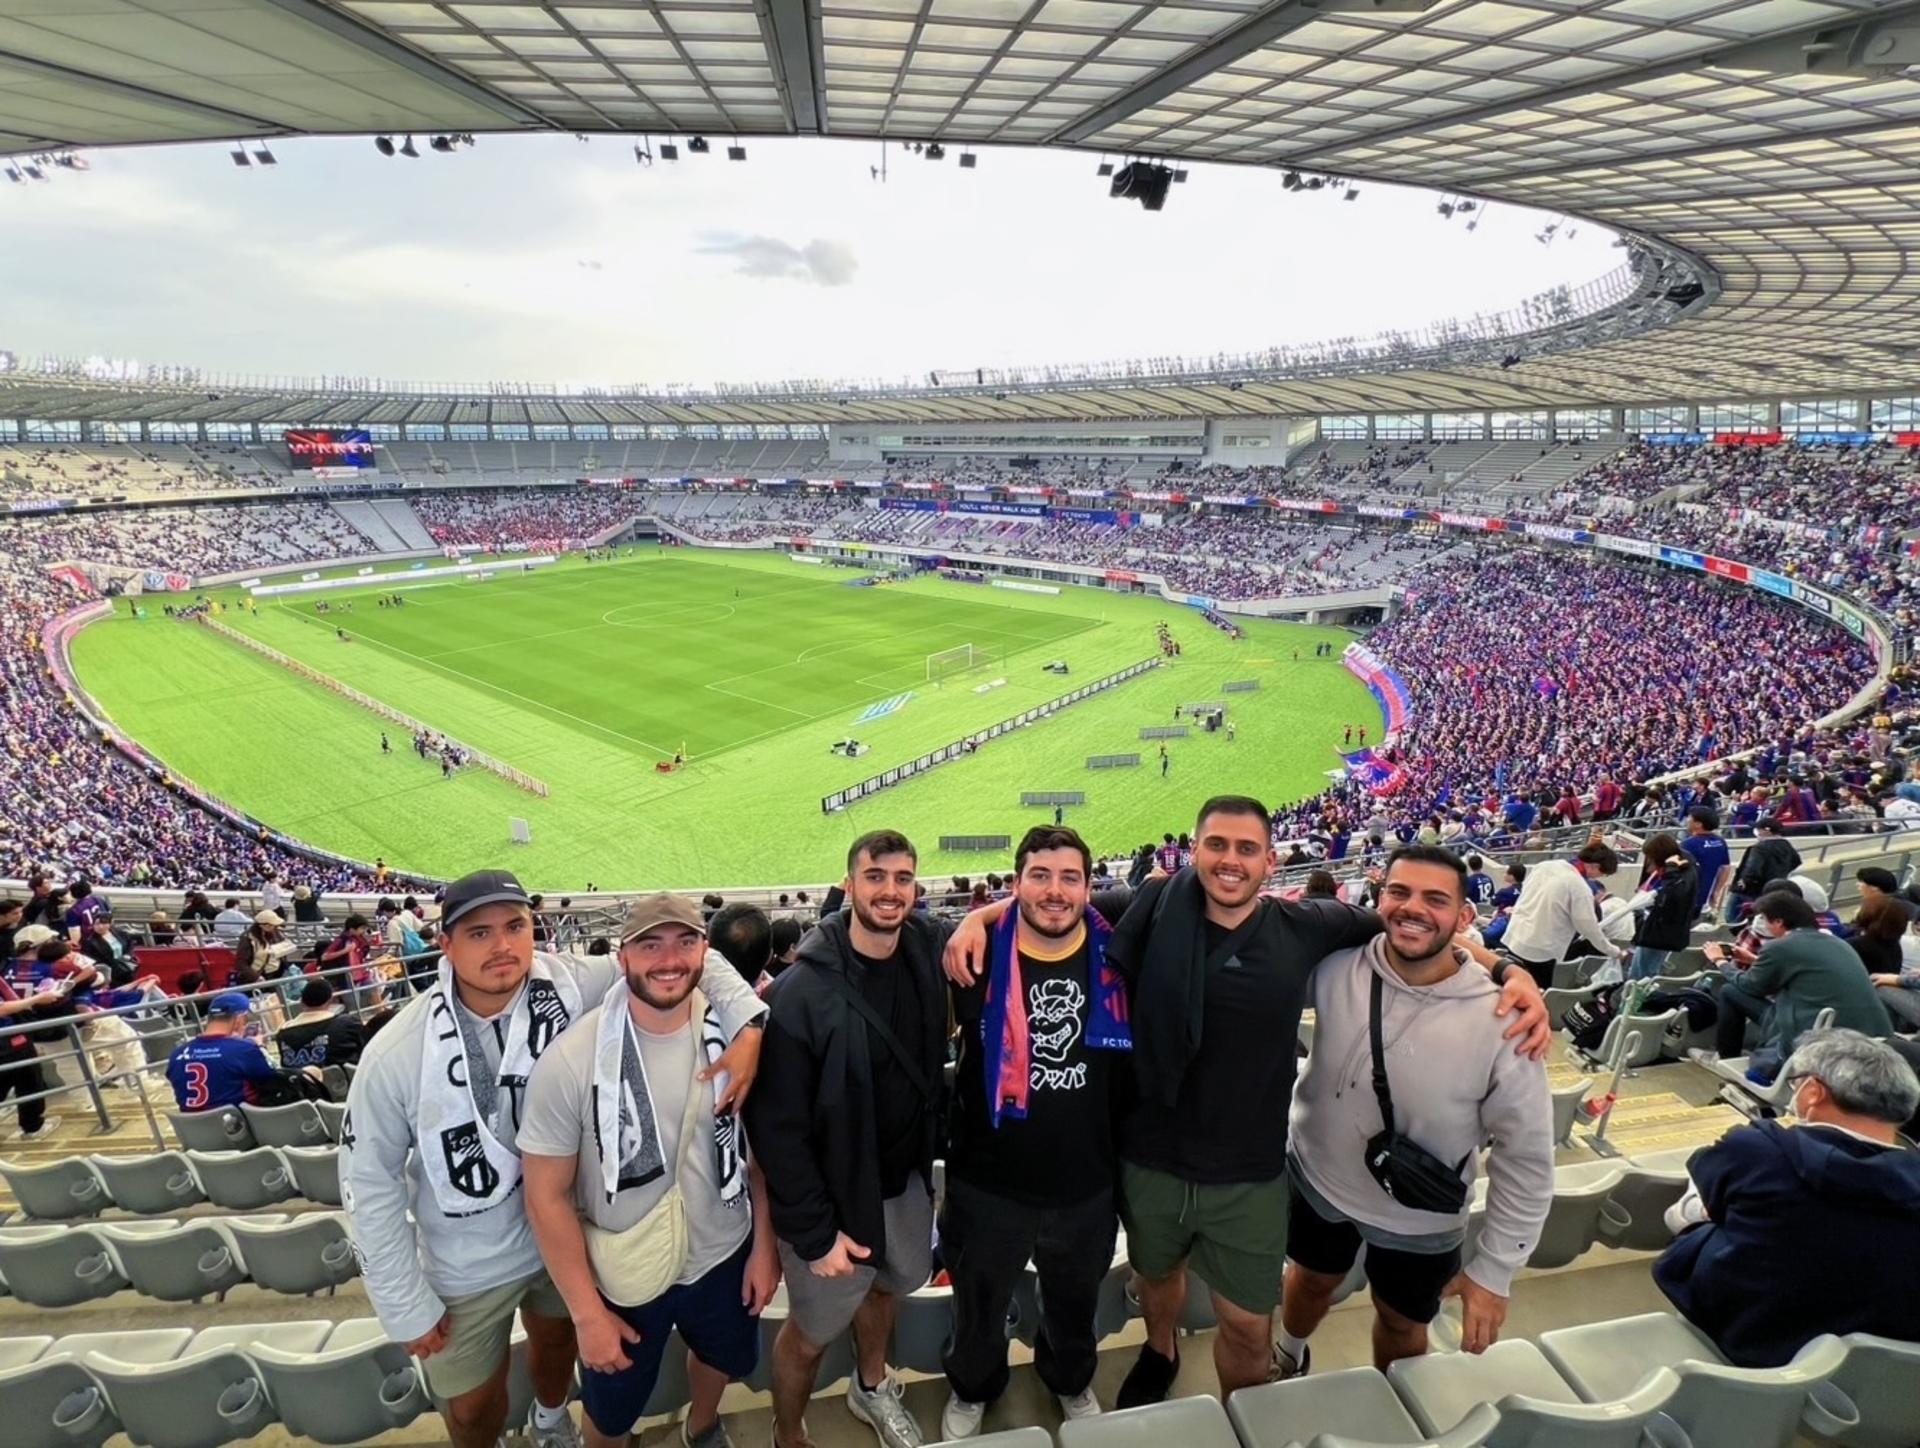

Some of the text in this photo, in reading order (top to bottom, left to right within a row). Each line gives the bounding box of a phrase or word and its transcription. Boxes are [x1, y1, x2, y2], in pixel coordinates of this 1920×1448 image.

[288, 442, 373, 454] WINNER
[1203, 495, 1246, 505] WINNER
[1279, 499, 1323, 510] WINNER
[1358, 505, 1404, 518] WINNER
[1439, 512, 1488, 528] WINNER
[1525, 525, 1575, 541] WINNER
[1030, 1062, 1087, 1090] クッパ
[184, 1062, 210, 1108] 3
